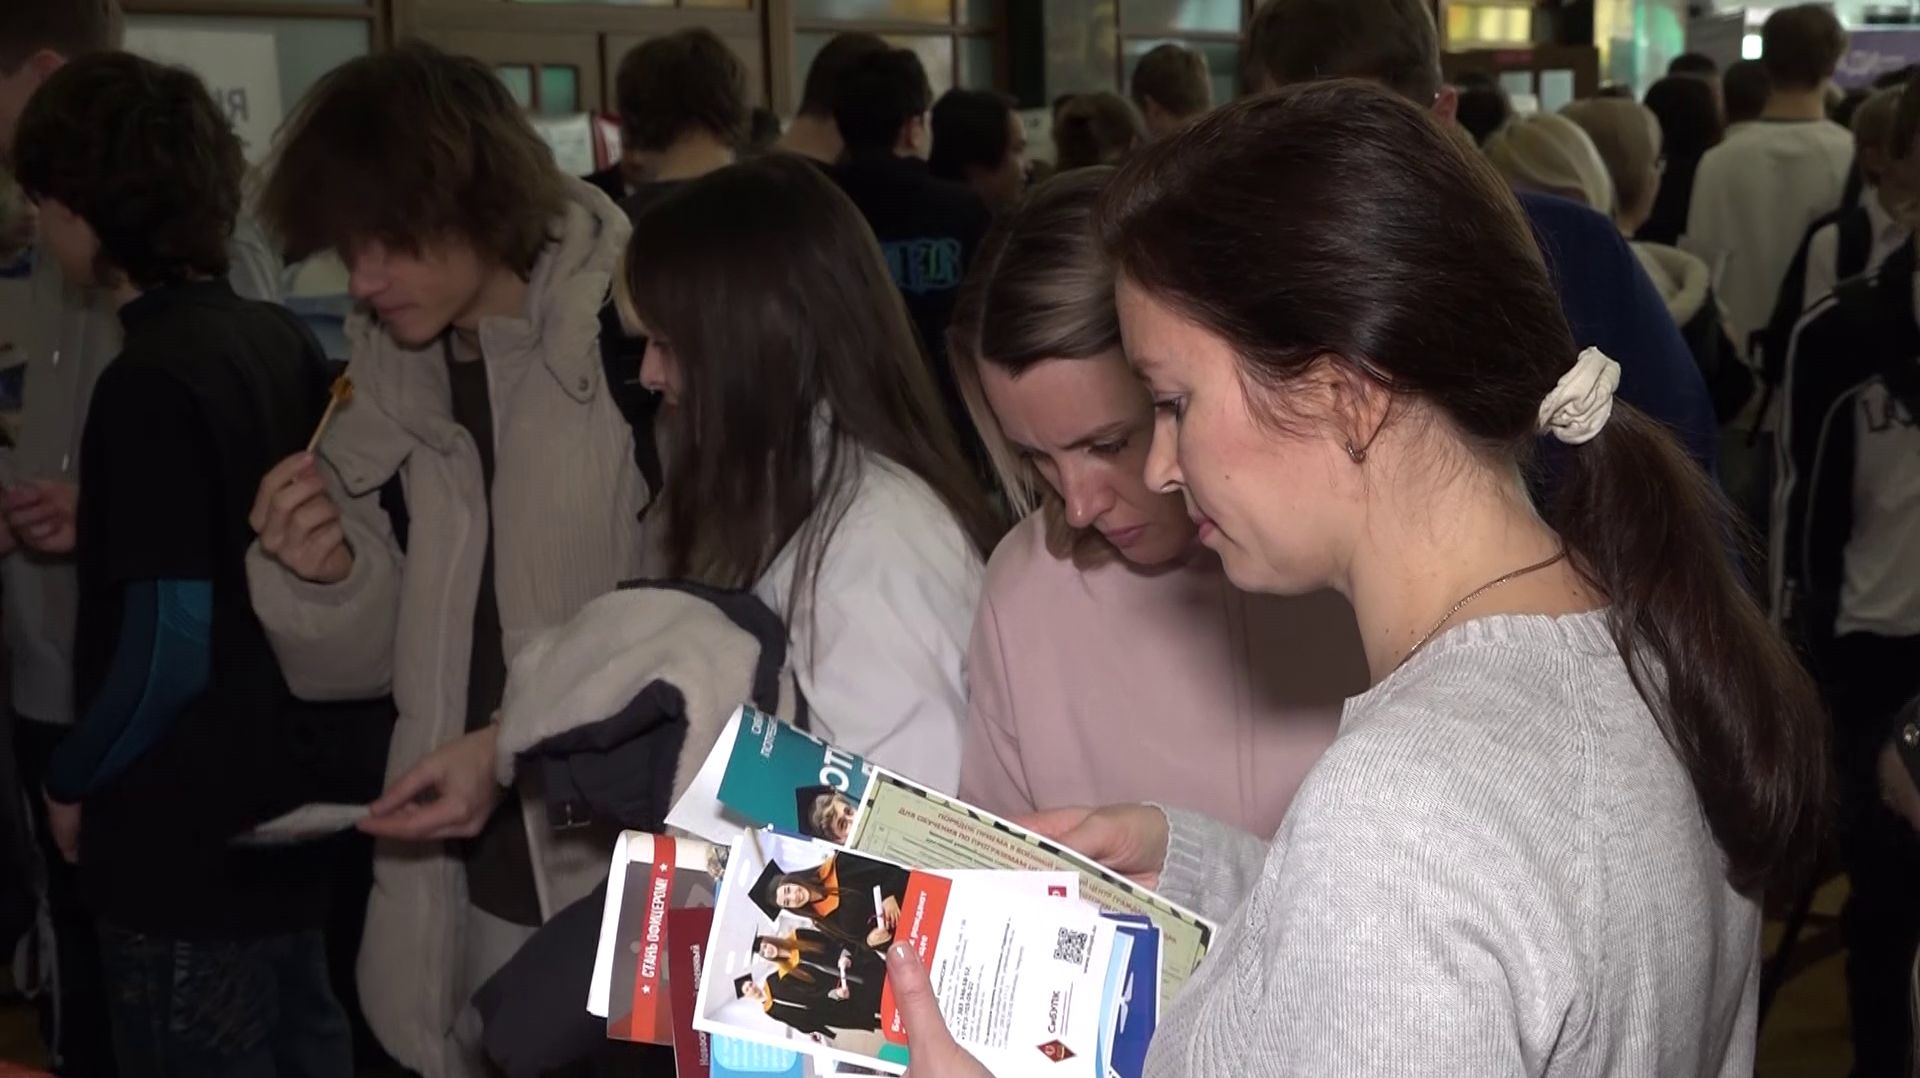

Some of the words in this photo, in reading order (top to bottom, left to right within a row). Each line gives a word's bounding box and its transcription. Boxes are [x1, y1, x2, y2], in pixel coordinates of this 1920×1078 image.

[646, 876, 669, 943] ОФИЦЕРОМ!
[910, 890, 927, 939] рождают
[641, 943, 659, 978] СТАНЬ
